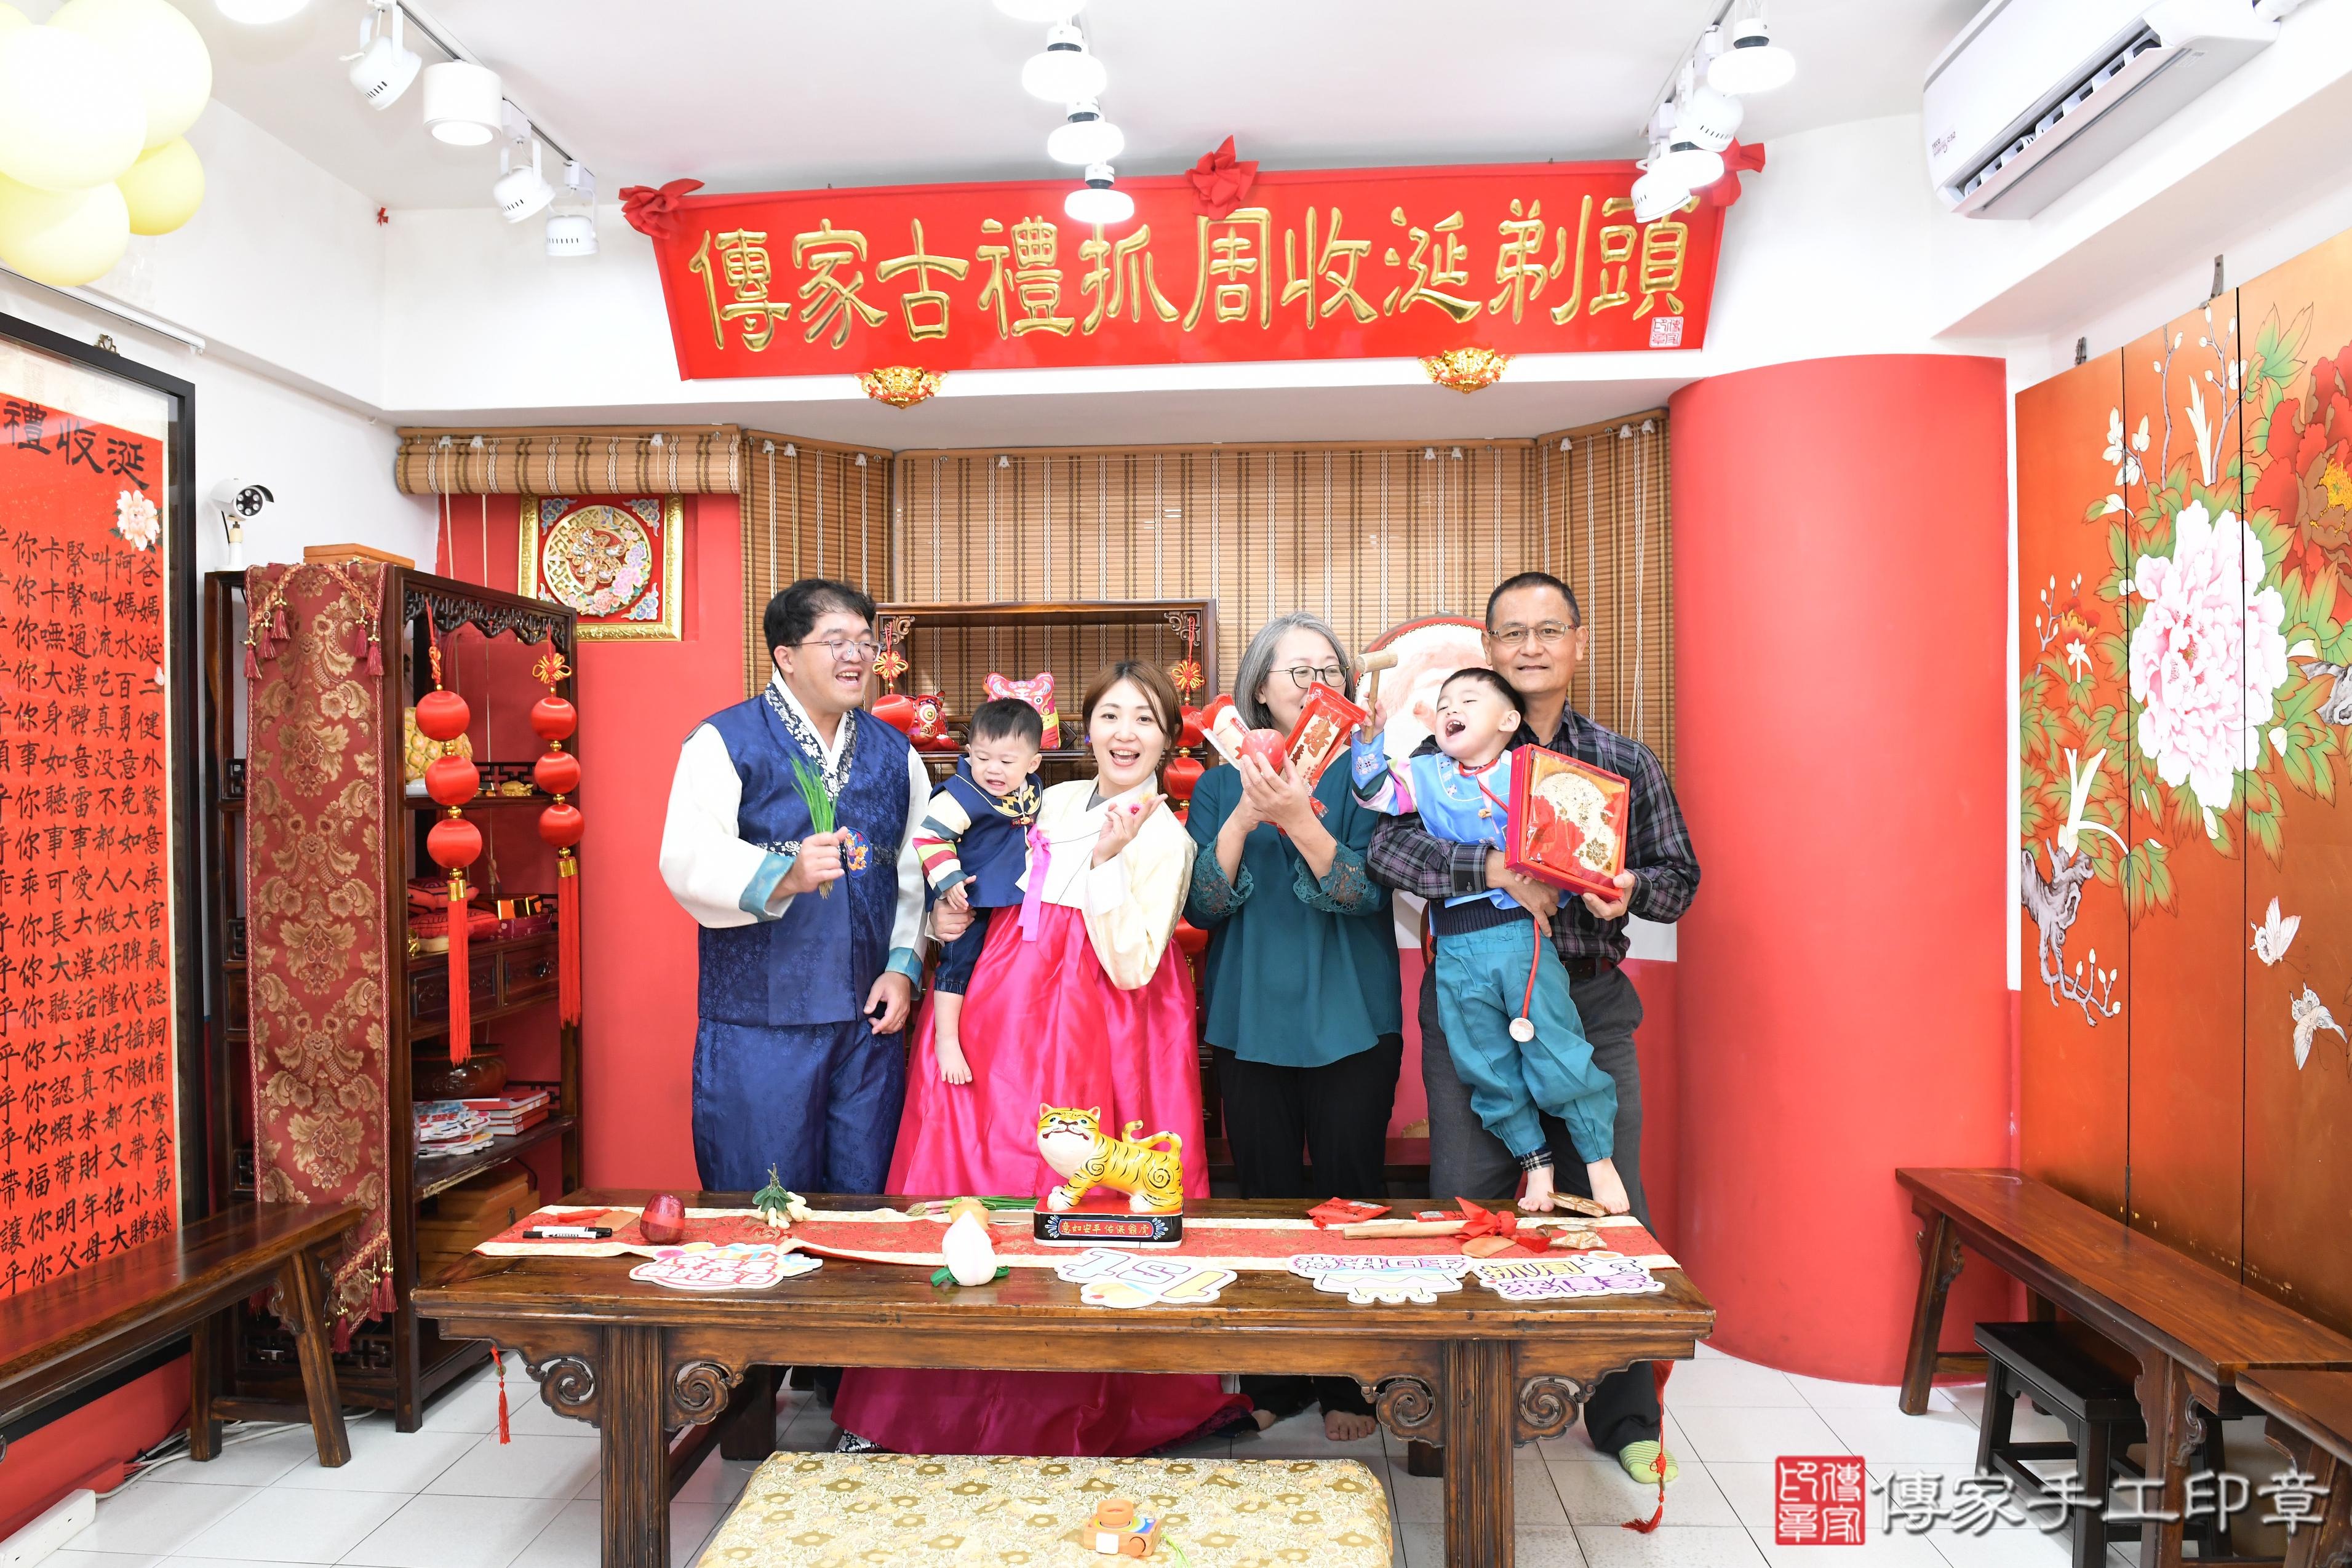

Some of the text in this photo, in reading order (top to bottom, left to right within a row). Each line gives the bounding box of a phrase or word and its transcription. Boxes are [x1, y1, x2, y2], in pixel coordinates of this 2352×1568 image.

[0, 526, 161, 586] 你卡緊叫阿爸
